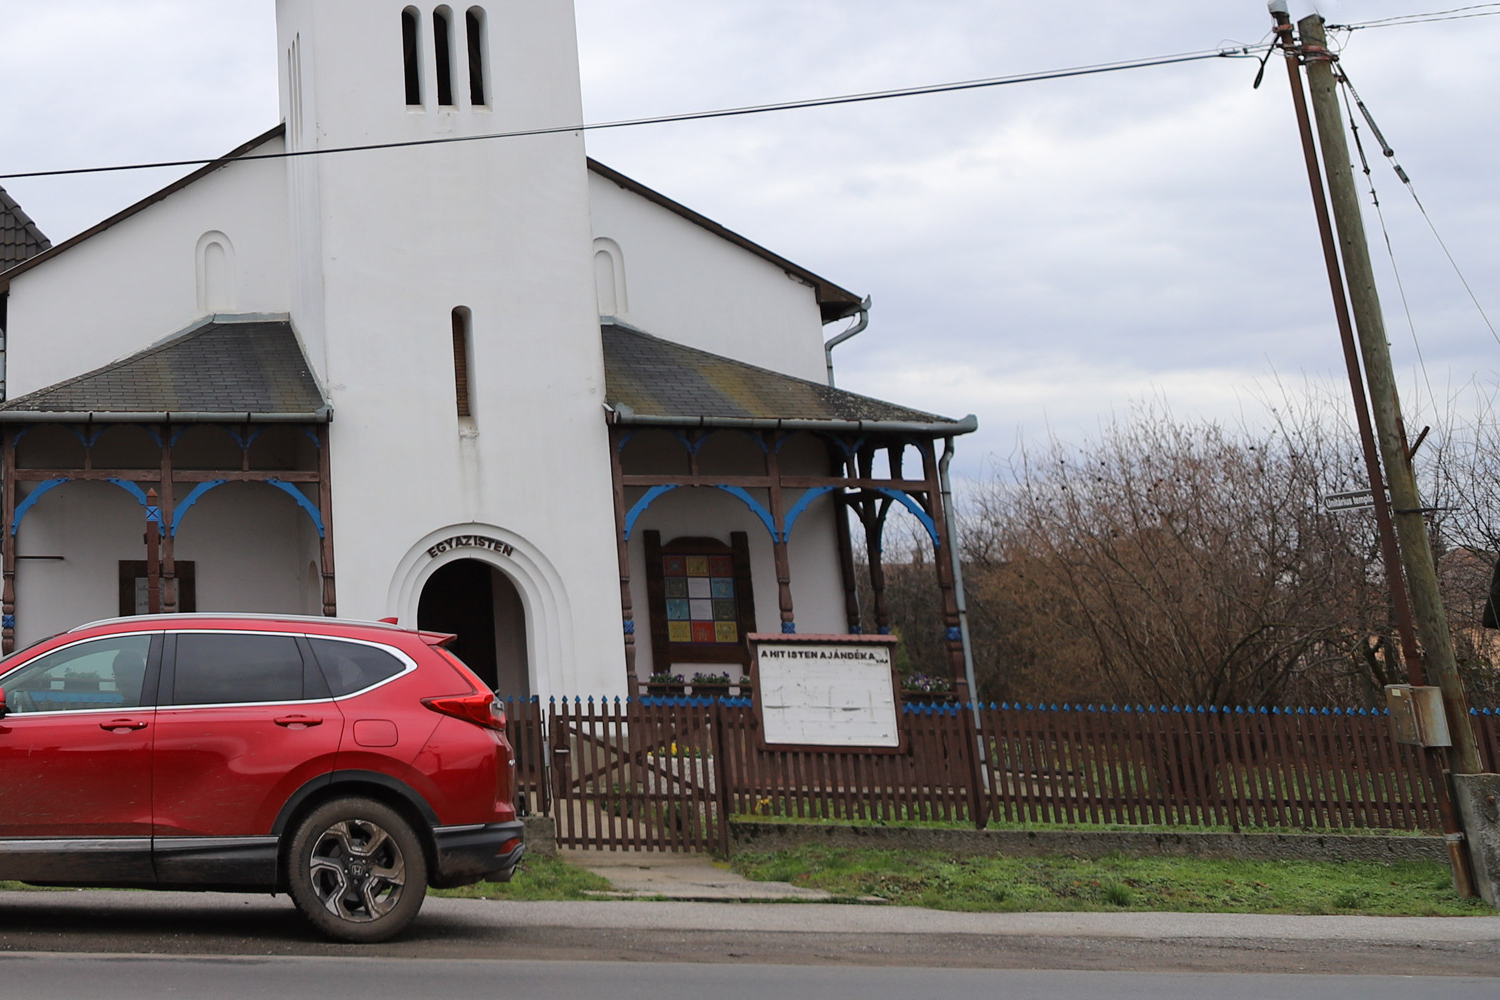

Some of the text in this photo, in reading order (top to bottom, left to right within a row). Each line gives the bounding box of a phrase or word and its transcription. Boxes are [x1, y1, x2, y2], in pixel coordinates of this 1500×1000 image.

[1353, 493, 1375, 506] templo
[761, 648, 876, 660] A HIT ISTEN AJÁNDÉKA
